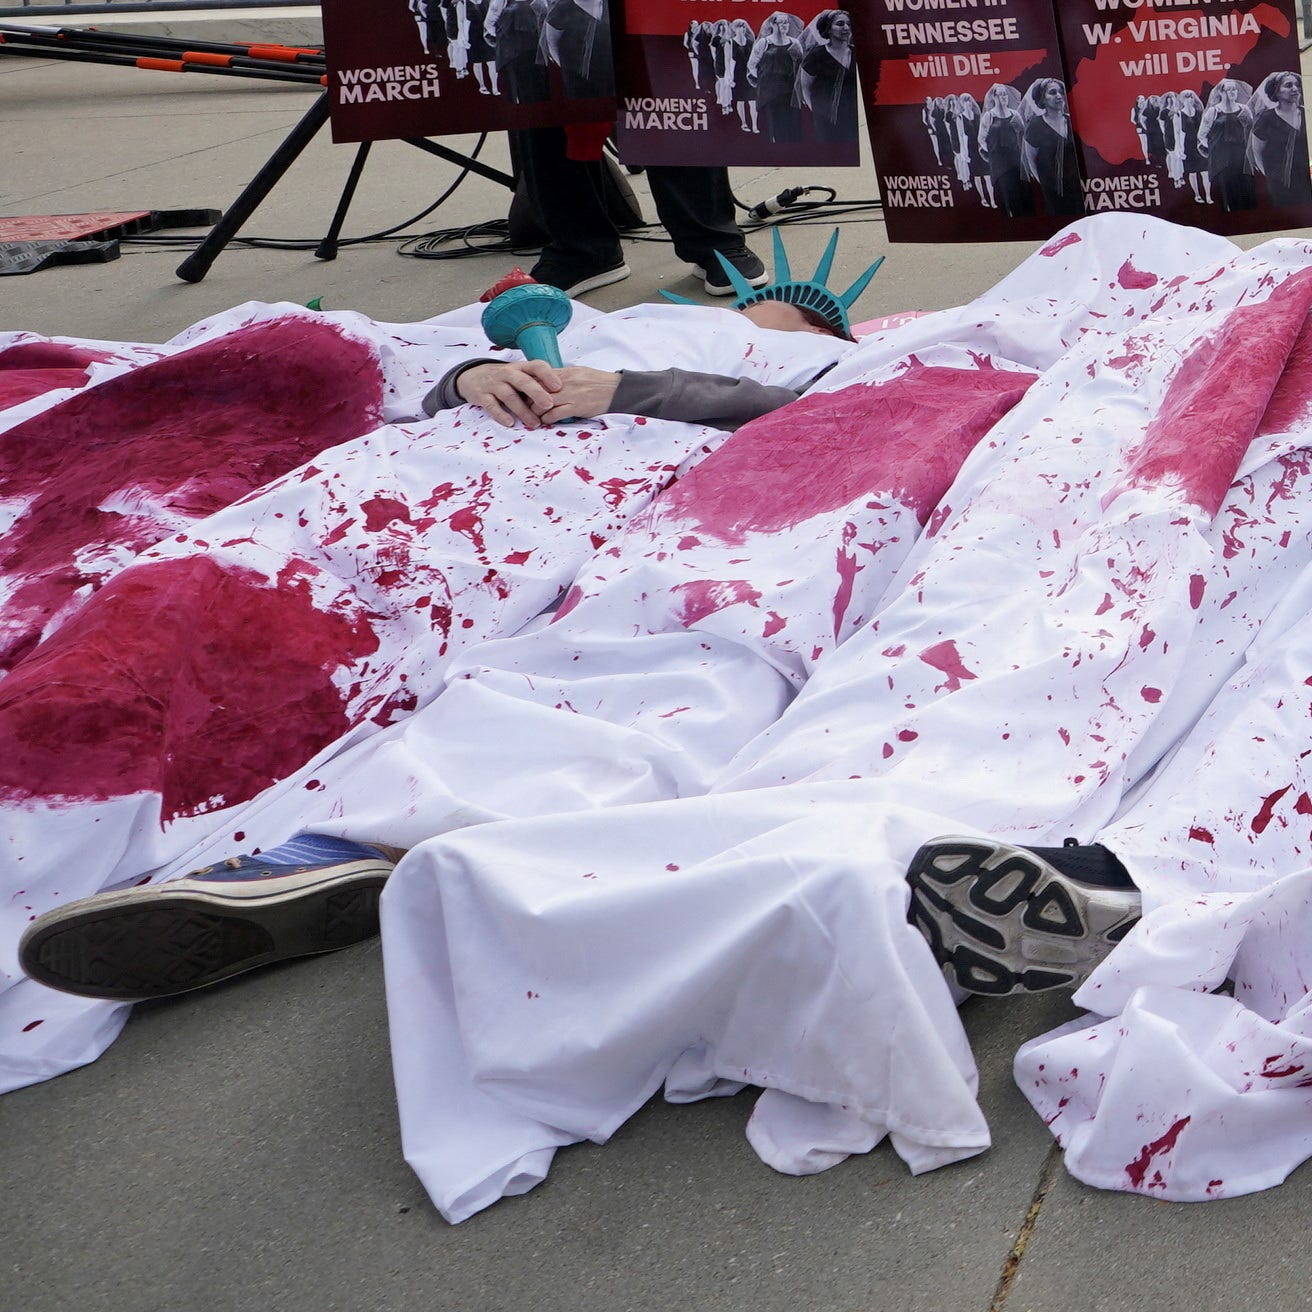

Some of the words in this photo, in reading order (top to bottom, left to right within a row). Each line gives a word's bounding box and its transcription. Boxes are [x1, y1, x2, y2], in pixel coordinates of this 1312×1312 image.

[882, 18, 1019, 44] TENNESSEE
[1082, 23, 1121, 44] W.
[1128, 13, 1260, 42] VIRGINIA
[909, 56, 948, 77] will
[953, 54, 1000, 76] DIE.
[1120, 53, 1168, 76] will
[1176, 50, 1230, 72] DIE.
[338, 64, 439, 85] WOMEN'S
[339, 79, 440, 104] MARCH
[625, 98, 706, 112] WOMEN'S
[626, 112, 707, 130] MARCH
[884, 175, 950, 189] WOMEN'S
[888, 190, 953, 207] MARCH
